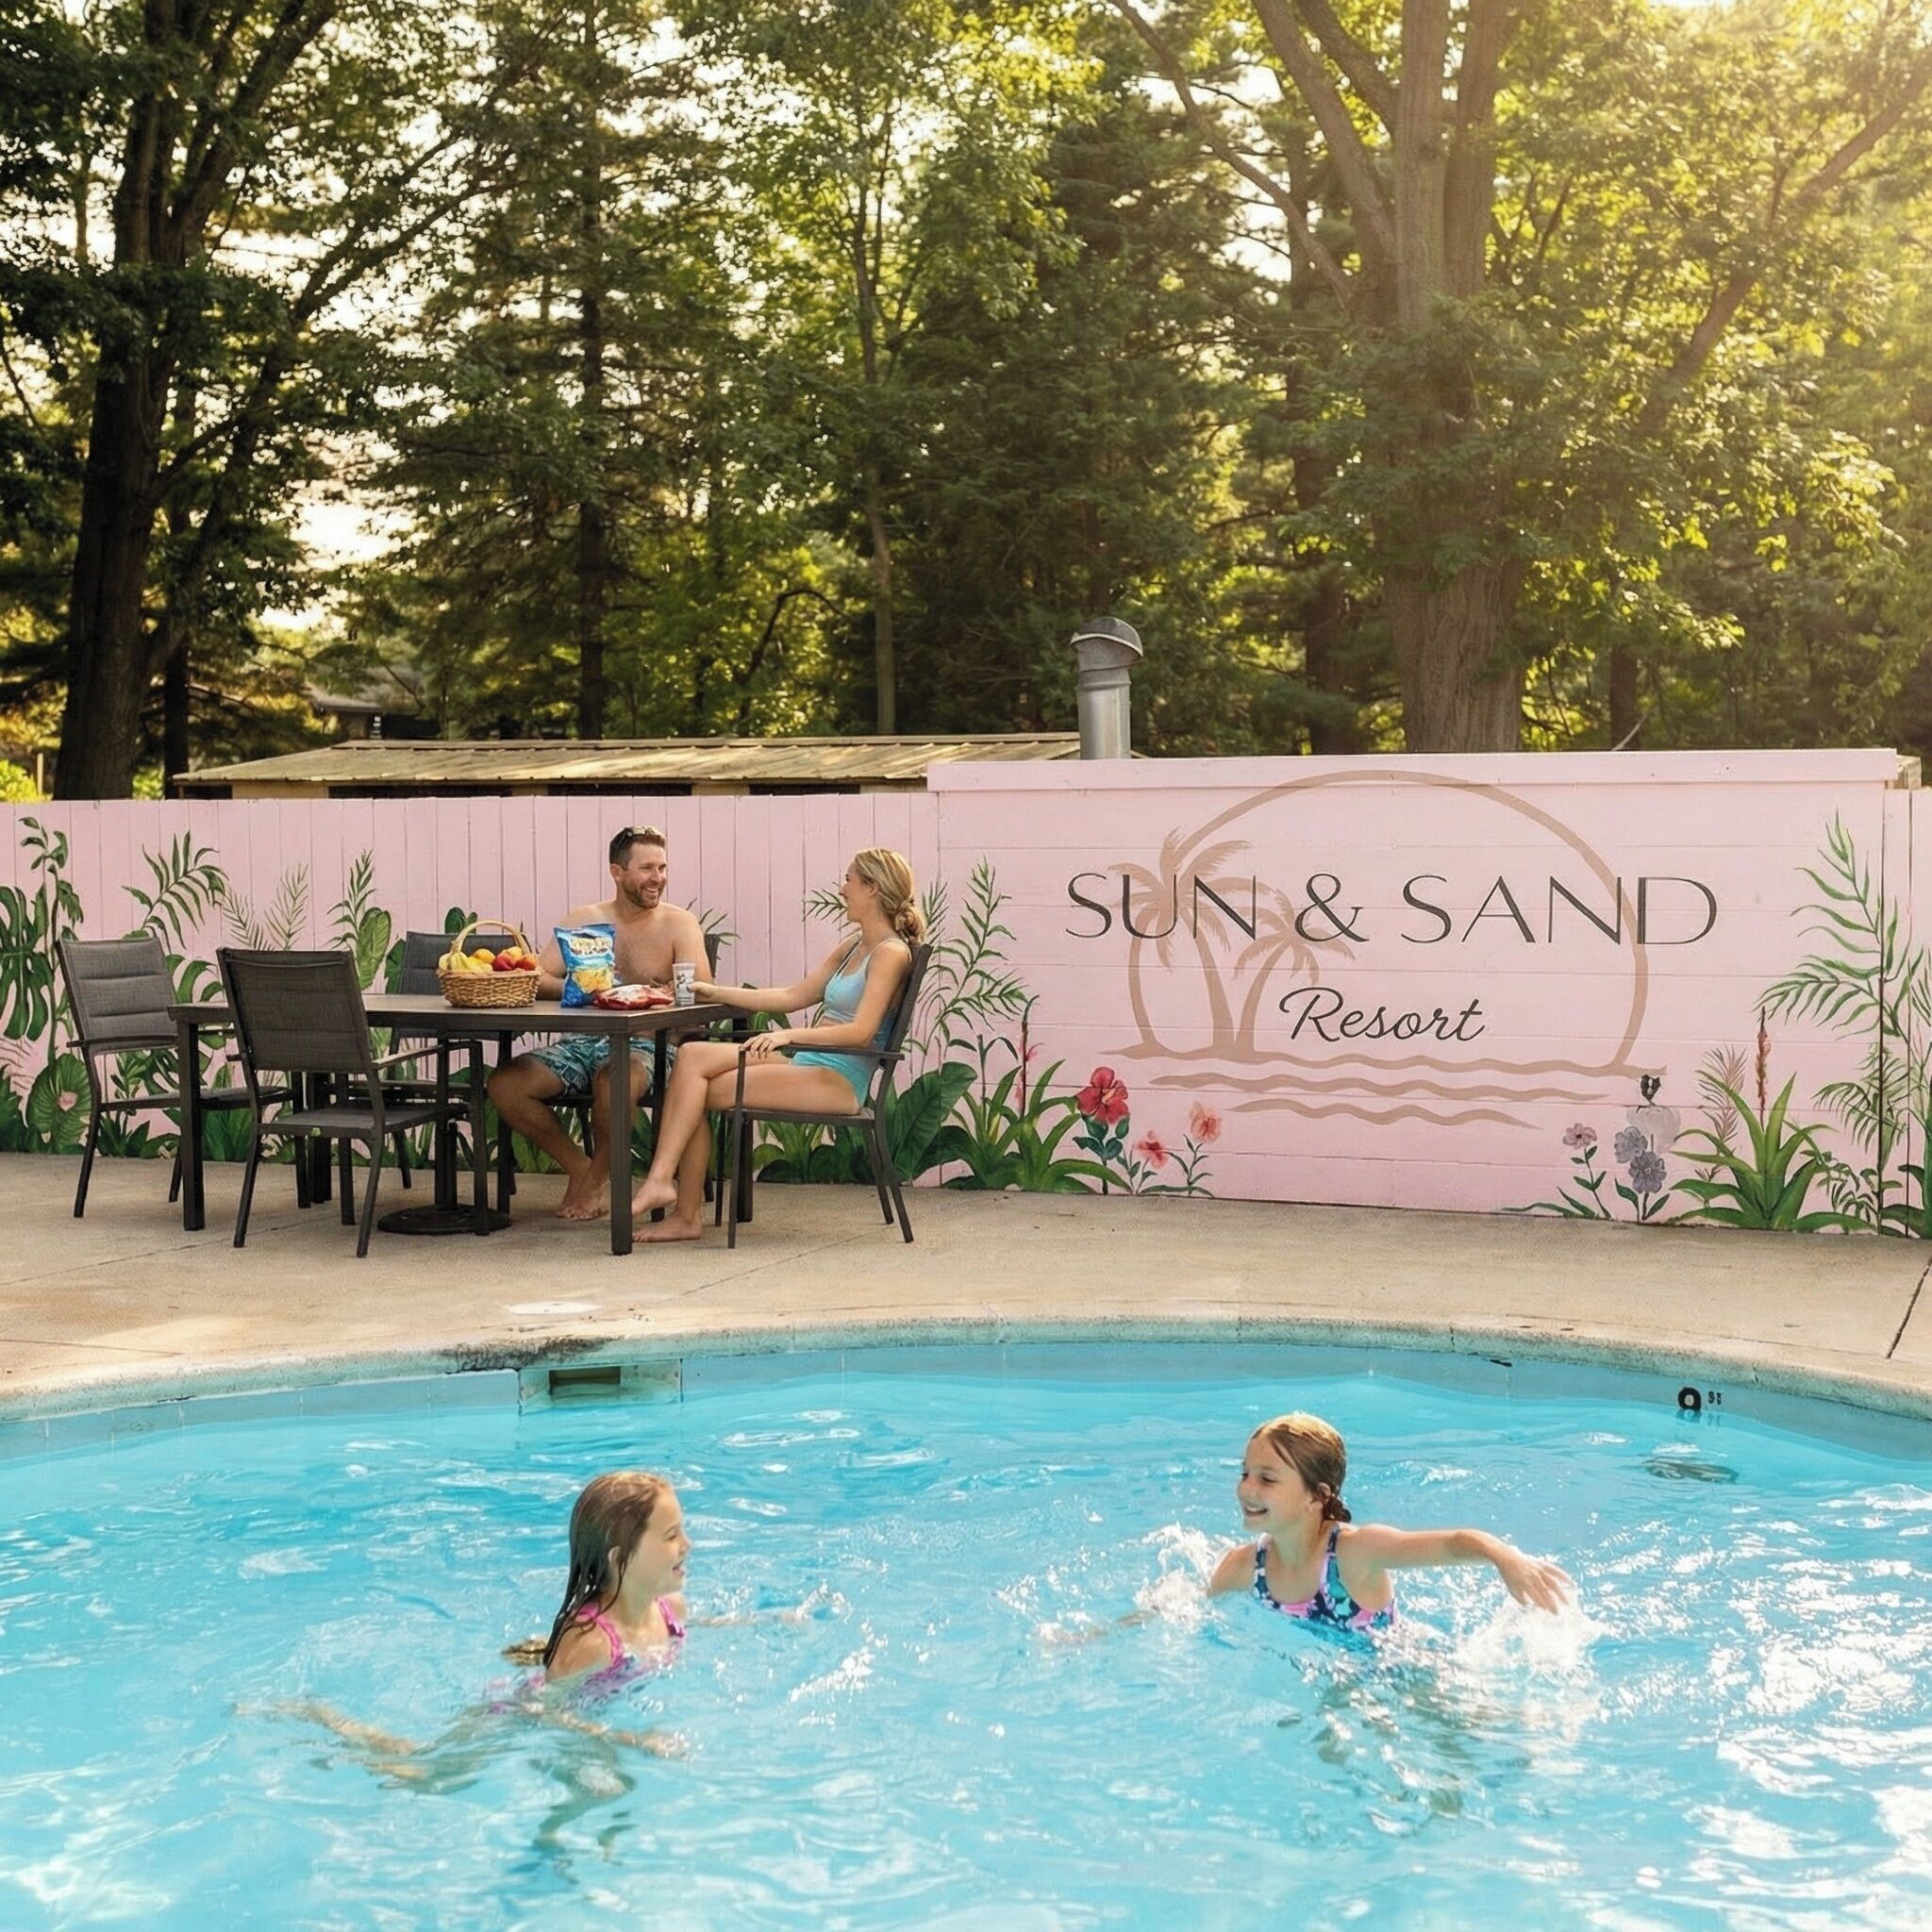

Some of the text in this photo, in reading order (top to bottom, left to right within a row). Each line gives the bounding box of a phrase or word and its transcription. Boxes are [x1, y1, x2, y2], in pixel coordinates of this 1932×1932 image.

[1065, 873, 1718, 945] SUN & SAND
[1278, 987, 1487, 1042] Resort
